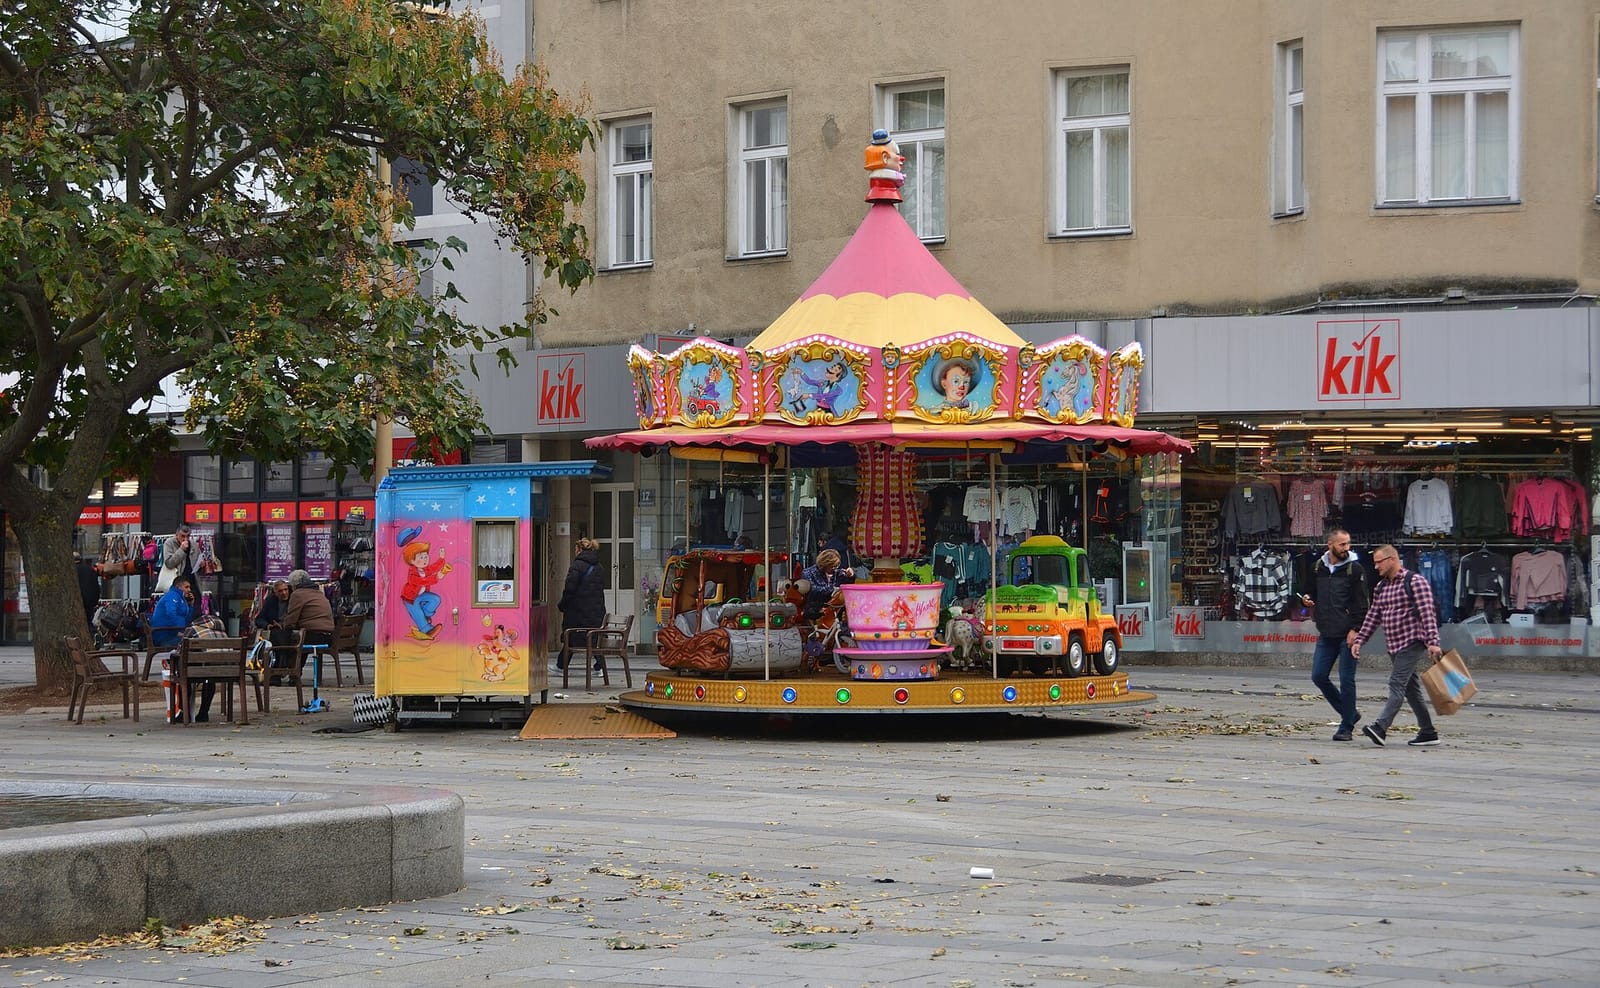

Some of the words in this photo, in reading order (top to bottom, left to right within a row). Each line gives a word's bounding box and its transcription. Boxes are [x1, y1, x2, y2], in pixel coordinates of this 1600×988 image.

[1321, 324, 1396, 395] kik
[539, 358, 583, 420] kik
[642, 491, 650, 501] 17
[1118, 610, 1142, 635] kik
[1174, 610, 1201, 635] kik
